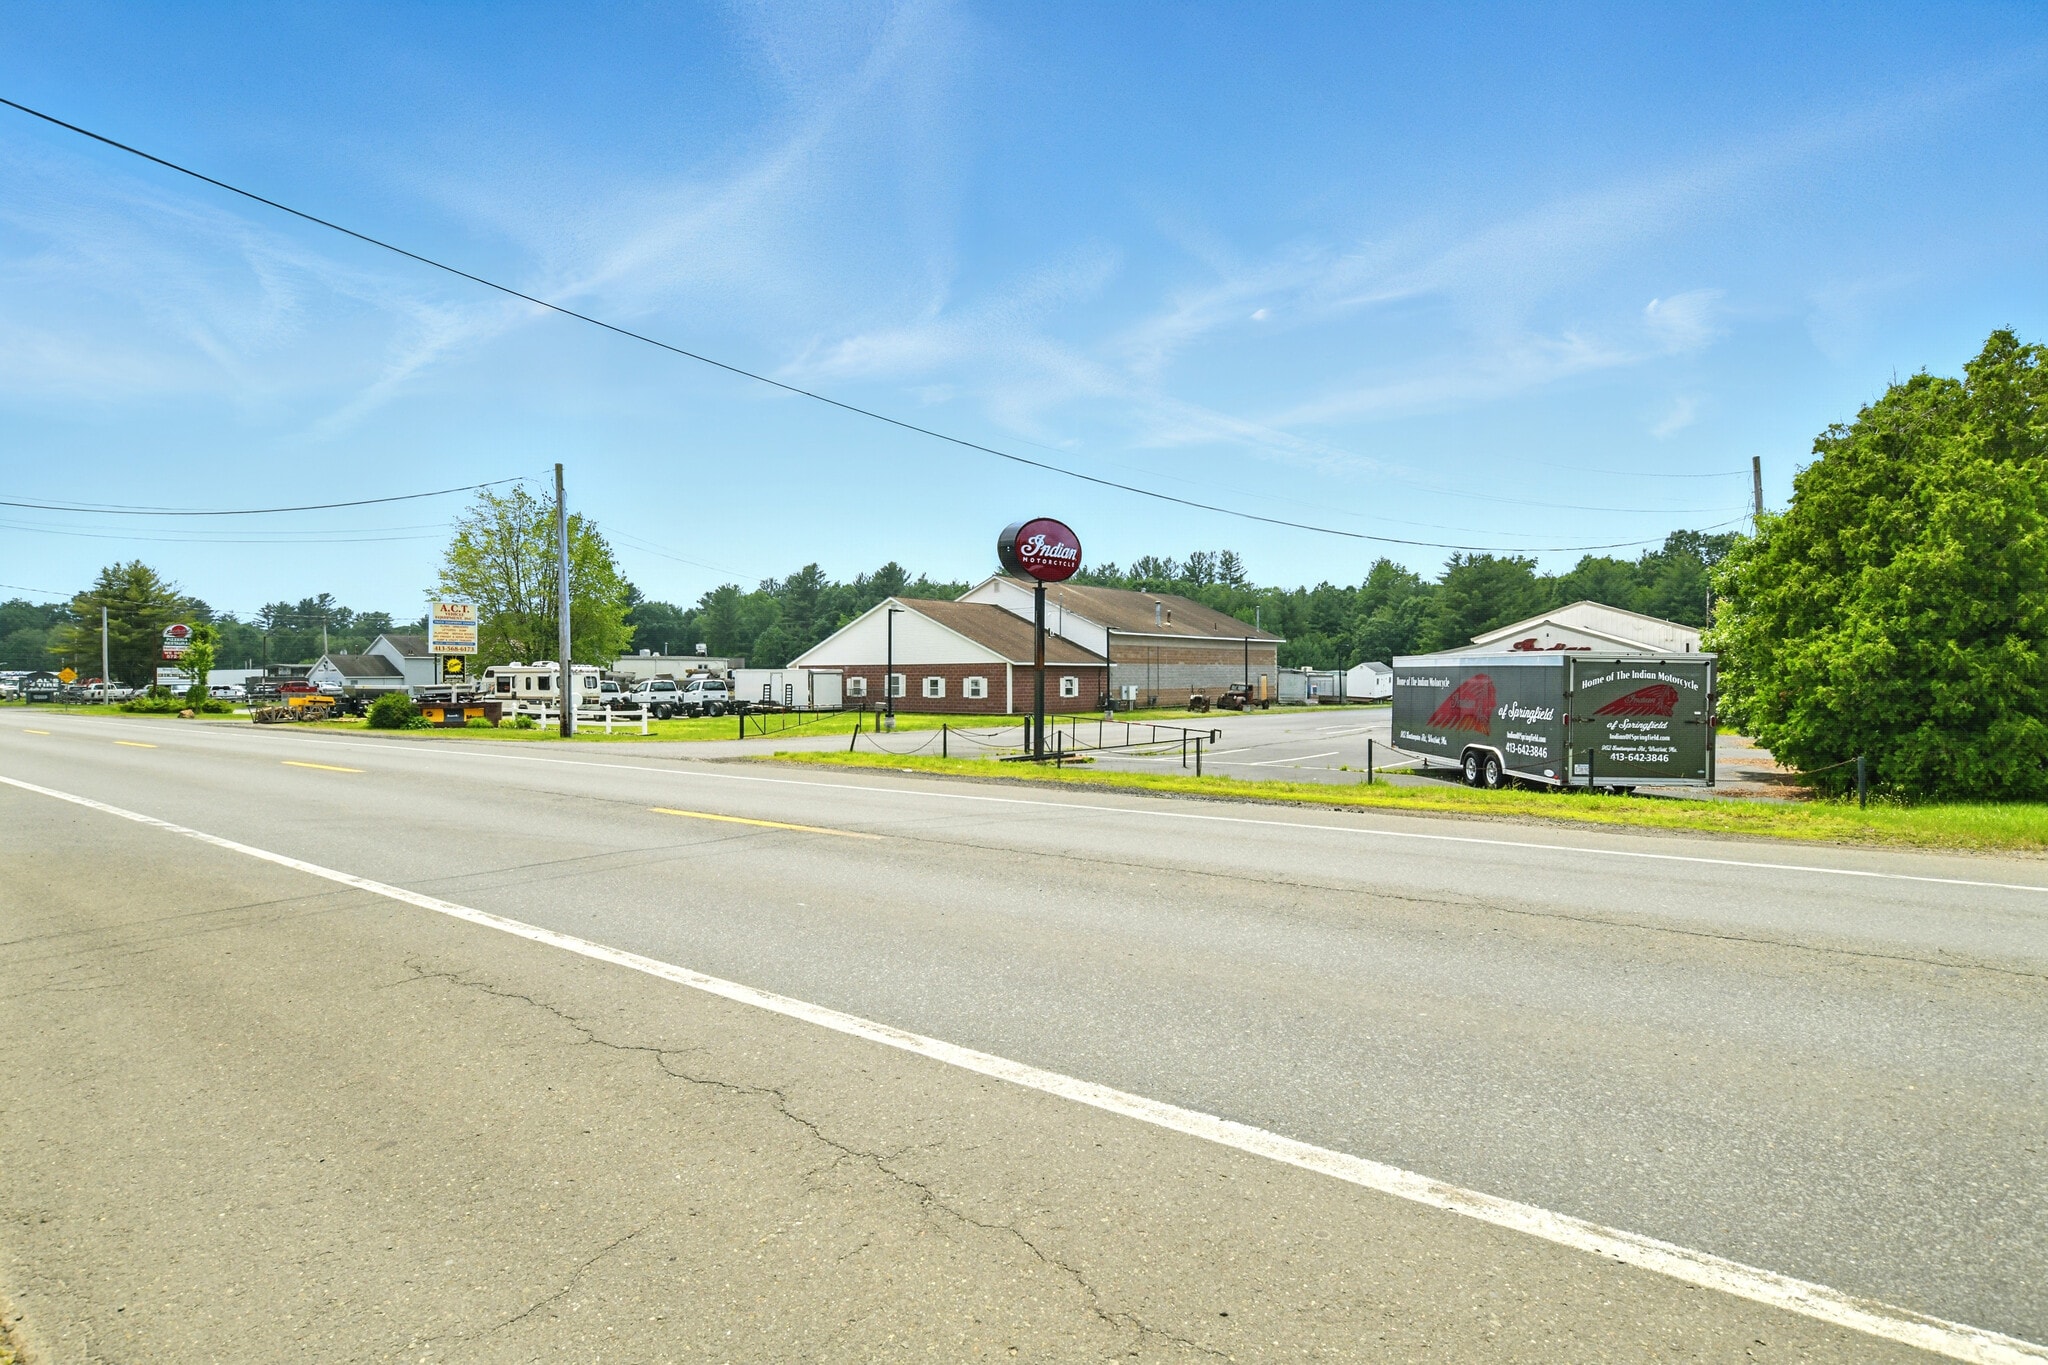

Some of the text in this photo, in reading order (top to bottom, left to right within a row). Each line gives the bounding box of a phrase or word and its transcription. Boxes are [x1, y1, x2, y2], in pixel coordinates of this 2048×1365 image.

[1020, 534, 1077, 560] Indian
[1022, 557, 1075, 567] MOTORCYCLE
[440, 604, 470, 613] A.C.T.
[1429, 677, 1450, 689] Motorcycle
[1582, 670, 1699, 691] Home of The Indian Motorcycle
[1498, 701, 1555, 725] of Springfield
[1606, 719, 1668, 731] of Springfield
[1506, 742, 1548, 758] 413-642-3846
[1610, 753, 1669, 762] 413-642-3846
